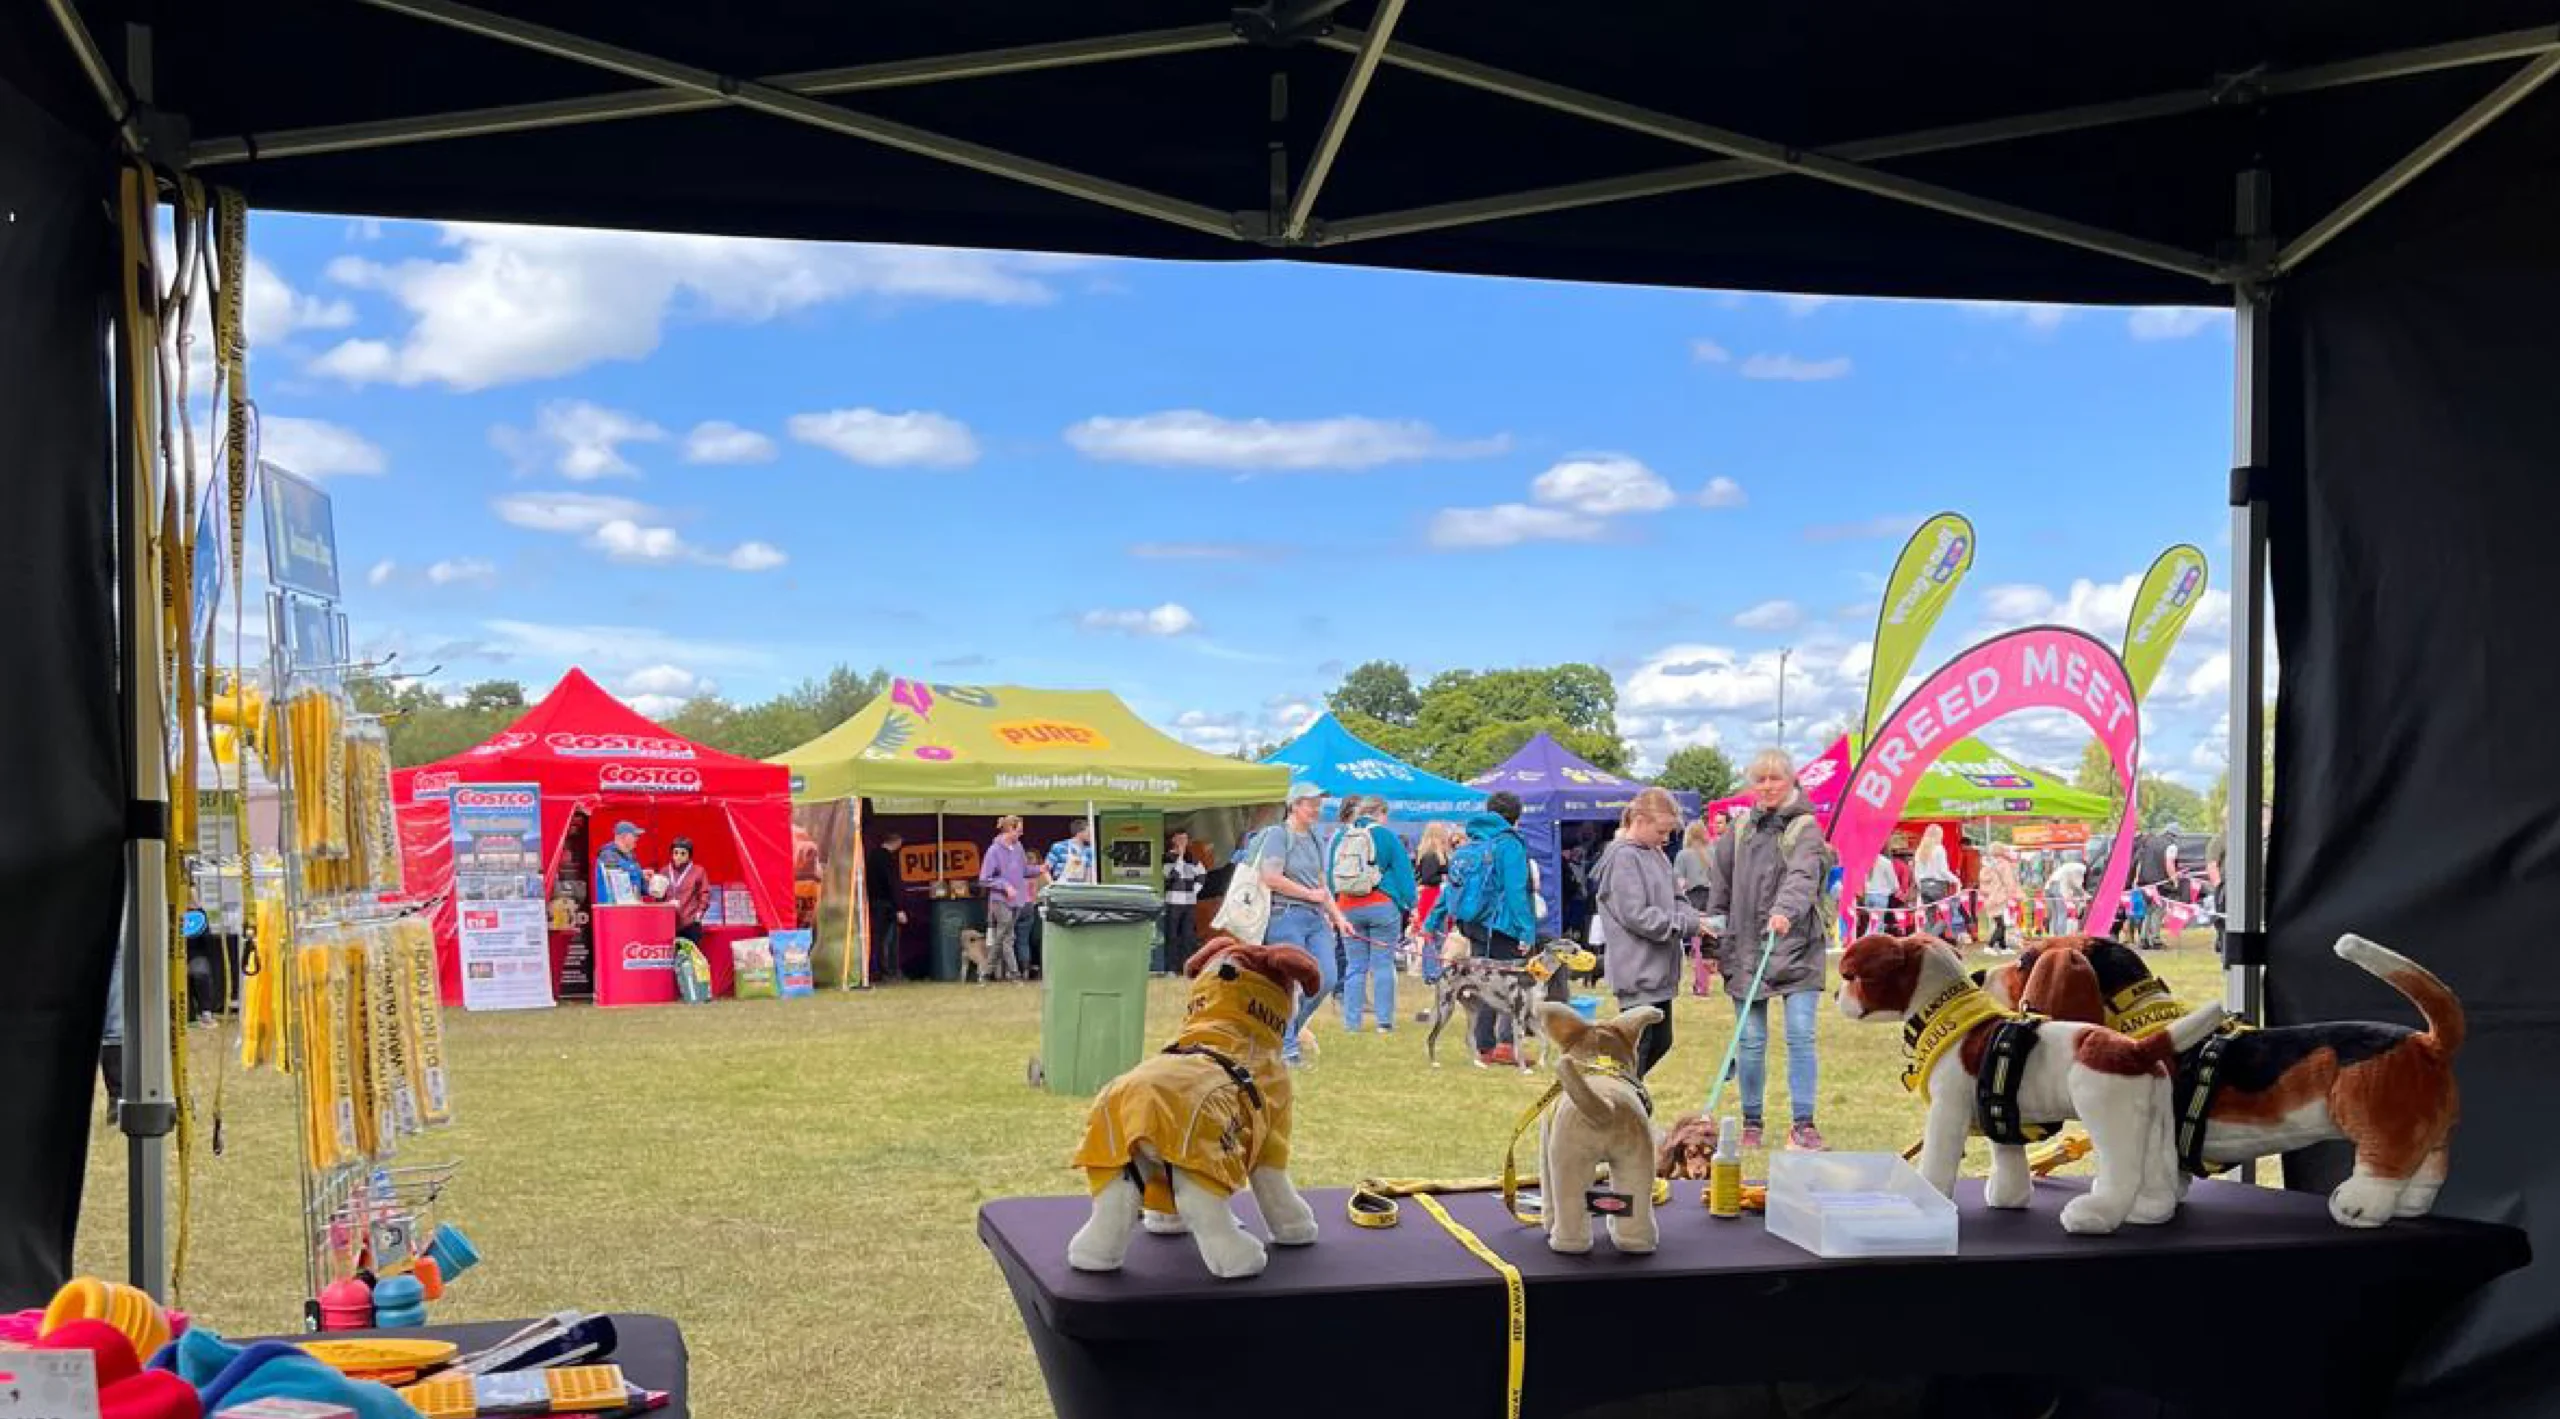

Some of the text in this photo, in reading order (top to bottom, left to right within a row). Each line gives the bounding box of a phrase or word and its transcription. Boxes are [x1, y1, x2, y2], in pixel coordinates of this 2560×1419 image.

[229, 398, 245, 453] AWAY
[230, 458, 244, 513] DOGS
[1856, 643, 2131, 808] BREED MEET
[546, 733, 694, 752] COSTCO
[601, 764, 699, 784] COSTCO
[458, 789, 535, 806] COSTCO
[420, 1008, 437, 1040] NOT
[425, 1046, 440, 1067] DO
[1511, 1279, 1523, 1342] KEEP AWAY
[1511, 1388, 1521, 1419] WAY
